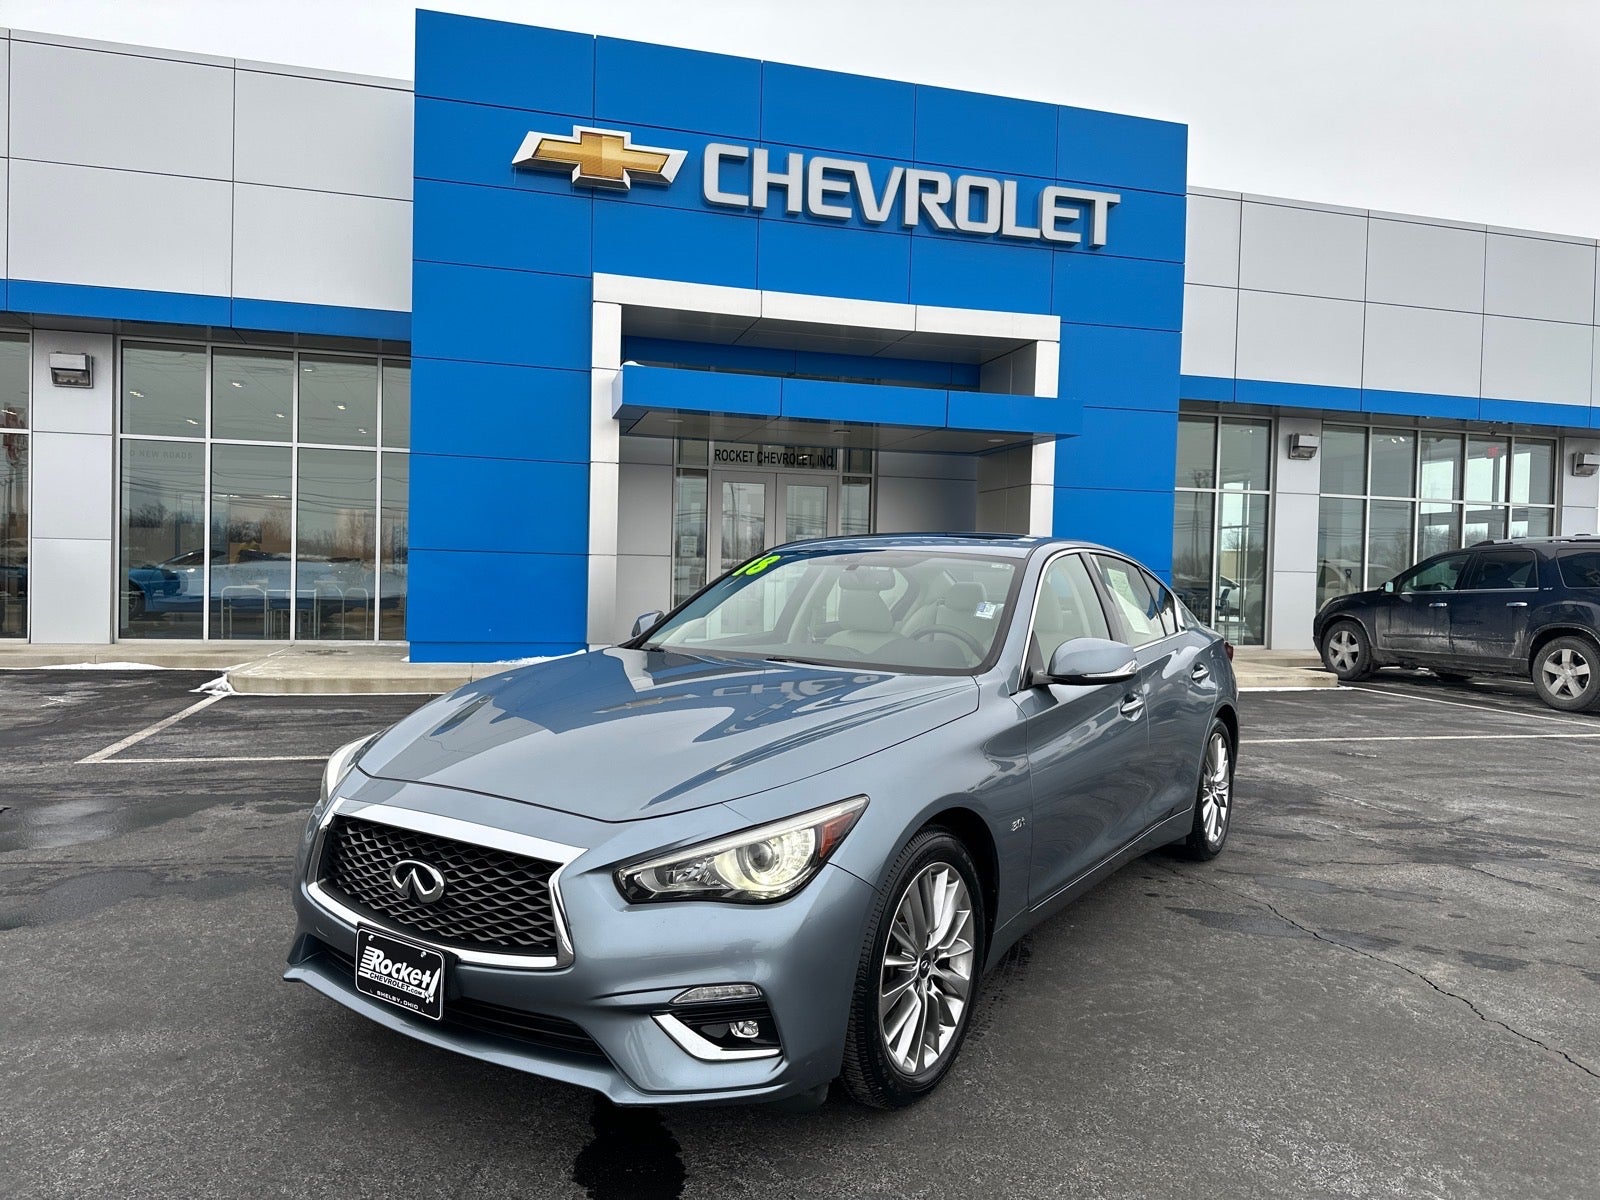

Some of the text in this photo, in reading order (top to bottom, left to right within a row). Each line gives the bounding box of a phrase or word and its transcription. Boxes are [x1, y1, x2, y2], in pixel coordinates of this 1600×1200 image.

[703, 142, 1121, 248] CHEVROLET
[714, 449, 755, 463] ROCKET
[403, 1000, 419, 1010] OHIO
